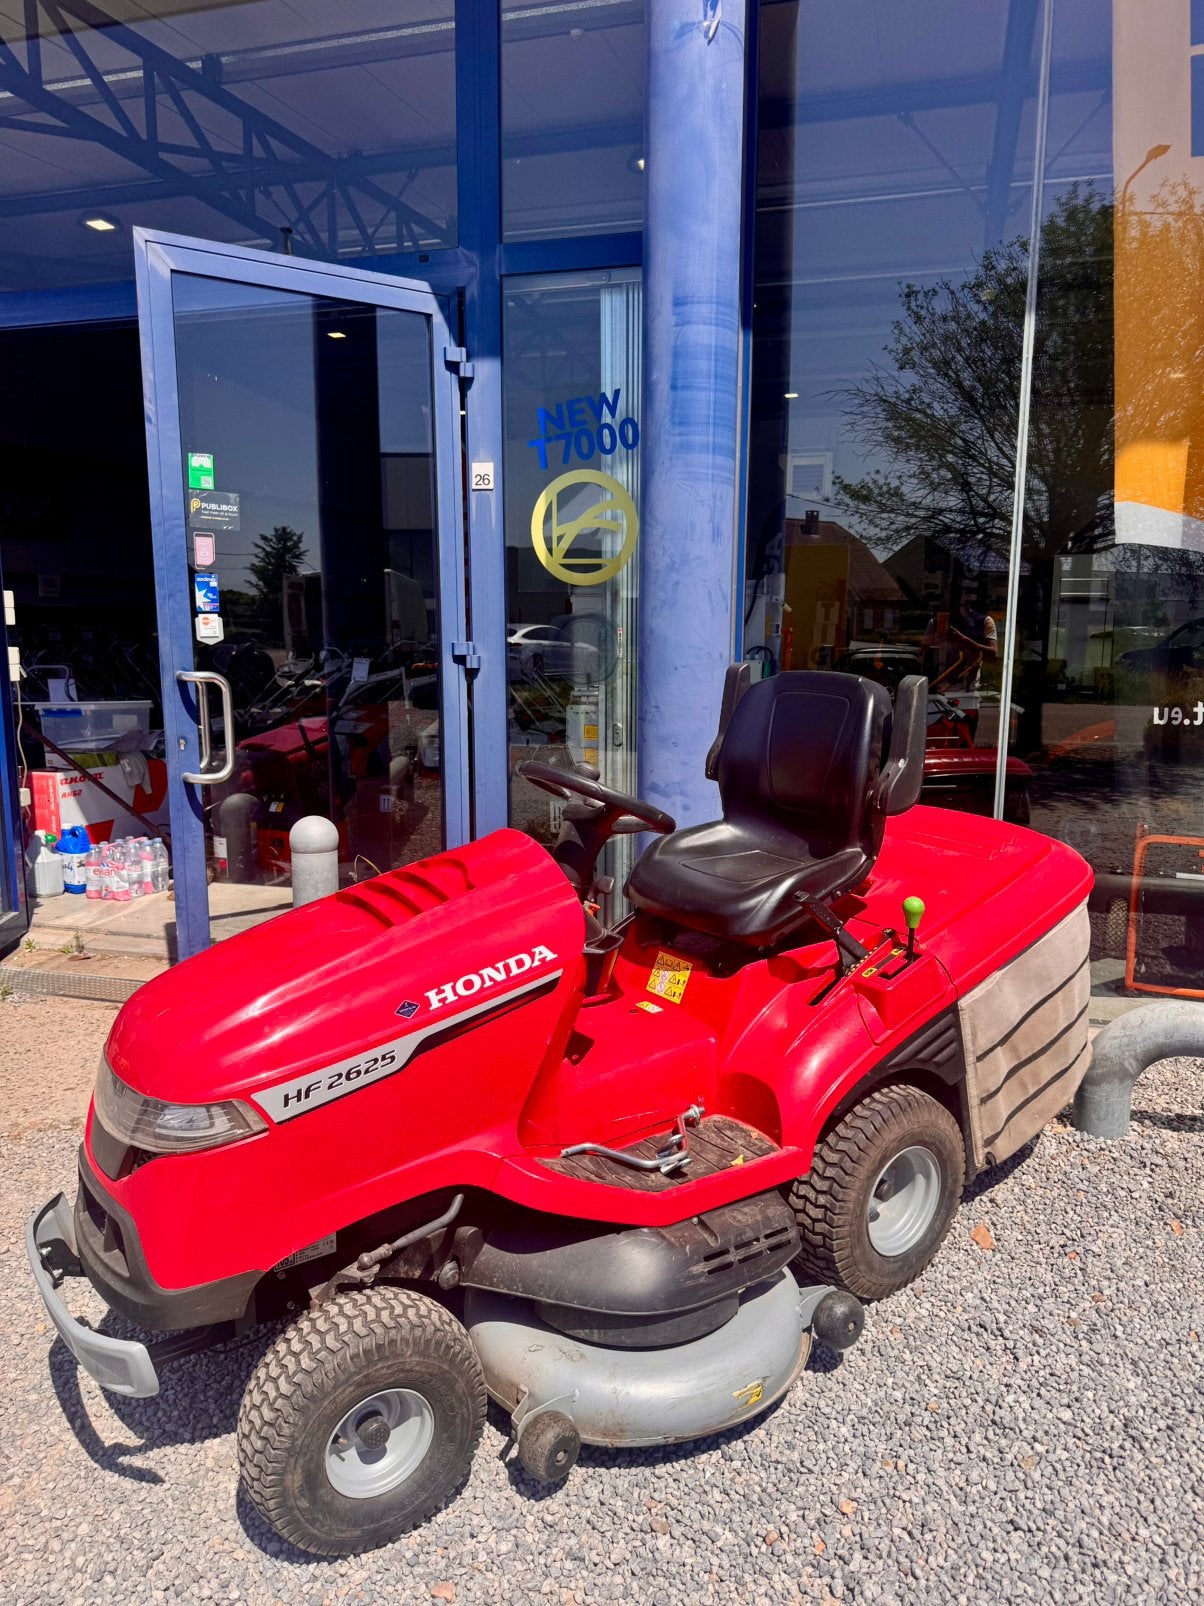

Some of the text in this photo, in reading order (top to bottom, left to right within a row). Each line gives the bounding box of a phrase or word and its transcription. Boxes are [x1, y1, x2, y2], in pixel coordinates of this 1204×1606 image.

[536, 388, 621, 435] NEW
[528, 417, 639, 470] T7000
[474, 474, 490, 486] 26
[201, 502, 238, 512] PUBLIBOX
[424, 945, 558, 1011] HONDA
[283, 1049, 396, 1108] HF 2625
